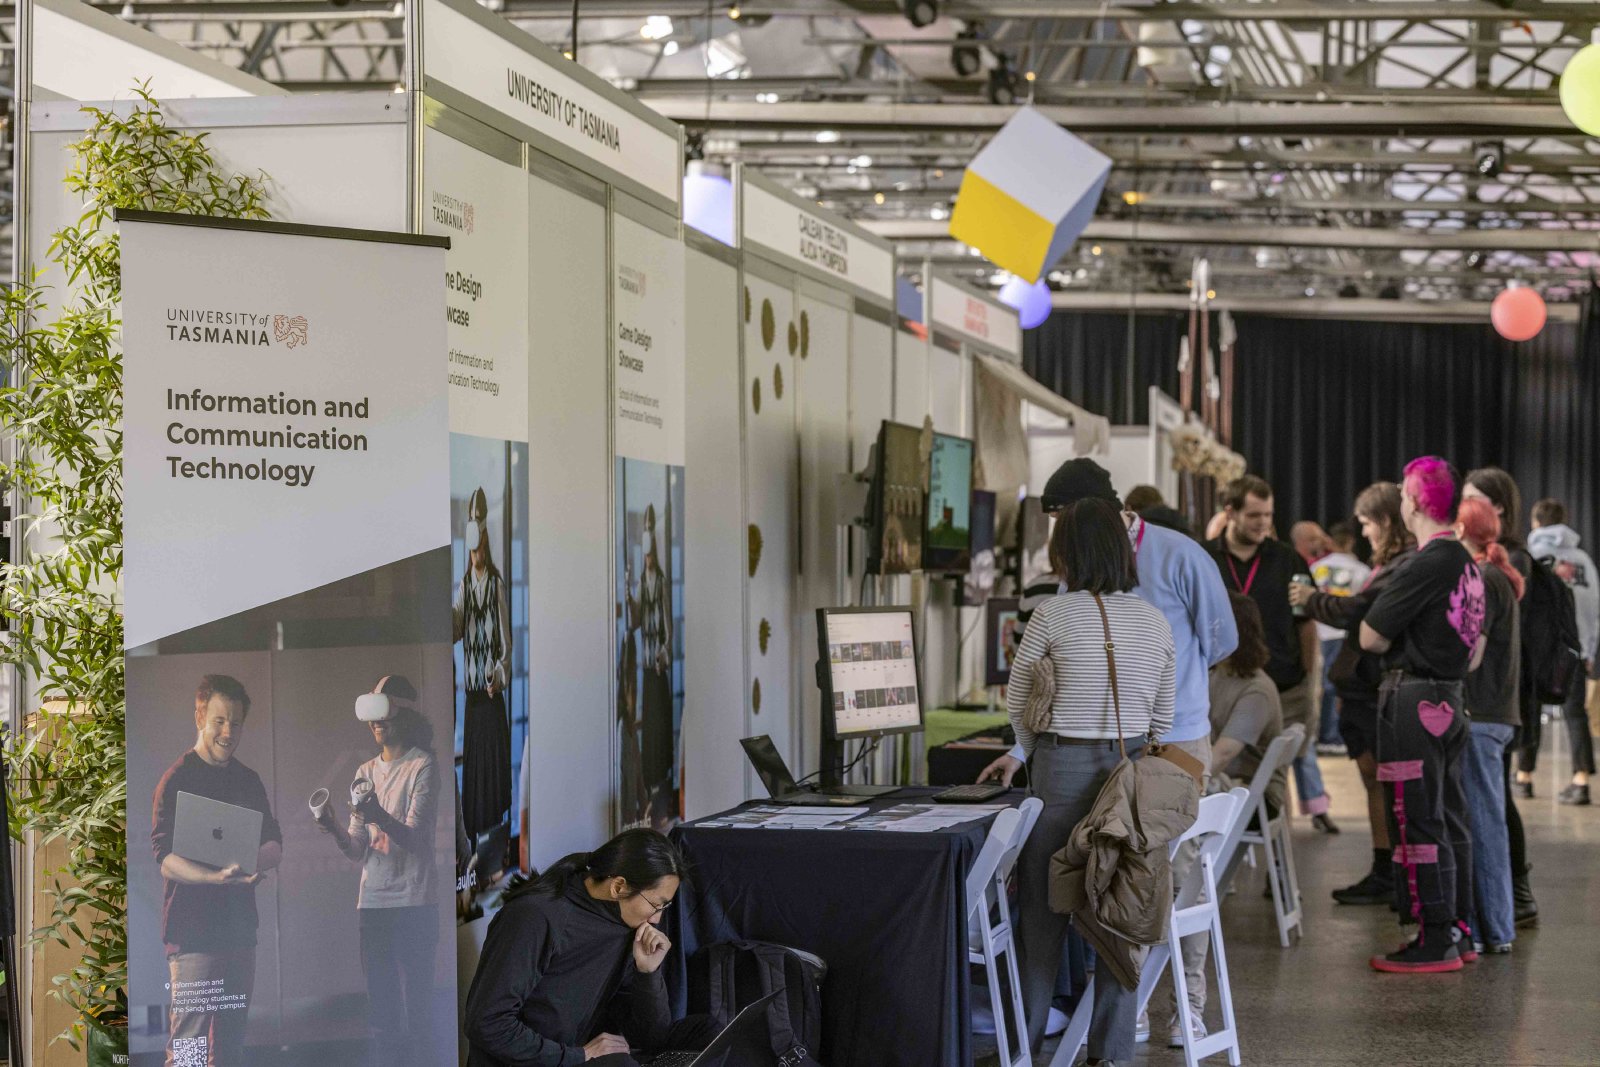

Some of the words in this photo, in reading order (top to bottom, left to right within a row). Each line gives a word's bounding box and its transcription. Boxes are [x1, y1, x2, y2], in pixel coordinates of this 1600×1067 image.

[507, 67, 562, 121] UNIVERSITY
[564, 100, 576, 128] OF
[578, 106, 620, 152] TASMANIA
[433, 190, 458, 210] UNIVERSITY
[433, 206, 463, 231] TASMANIA
[456, 271, 482, 302] Design
[167, 308, 257, 326] UNIVERSITY
[259, 314, 270, 328] of
[446, 305, 469, 327] wcase
[166, 324, 270, 346] TASMANIA
[634, 327, 652, 352] Design
[455, 350, 482, 369] Information
[483, 357, 494, 371] and
[619, 349, 644, 373] Showcase
[448, 371, 469, 388] unication
[470, 375, 500, 397] Technology
[167, 388, 316, 416] Information
[324, 397, 369, 418] and
[166, 422, 368, 451] Communication
[166, 456, 315, 487] Technology
[173, 979, 210, 988] Information
[173, 987, 224, 997] Communication
[173, 996, 209, 1005] Technology
[211, 994, 239, 1002] students
[185, 1005, 206, 1013] Sandy
